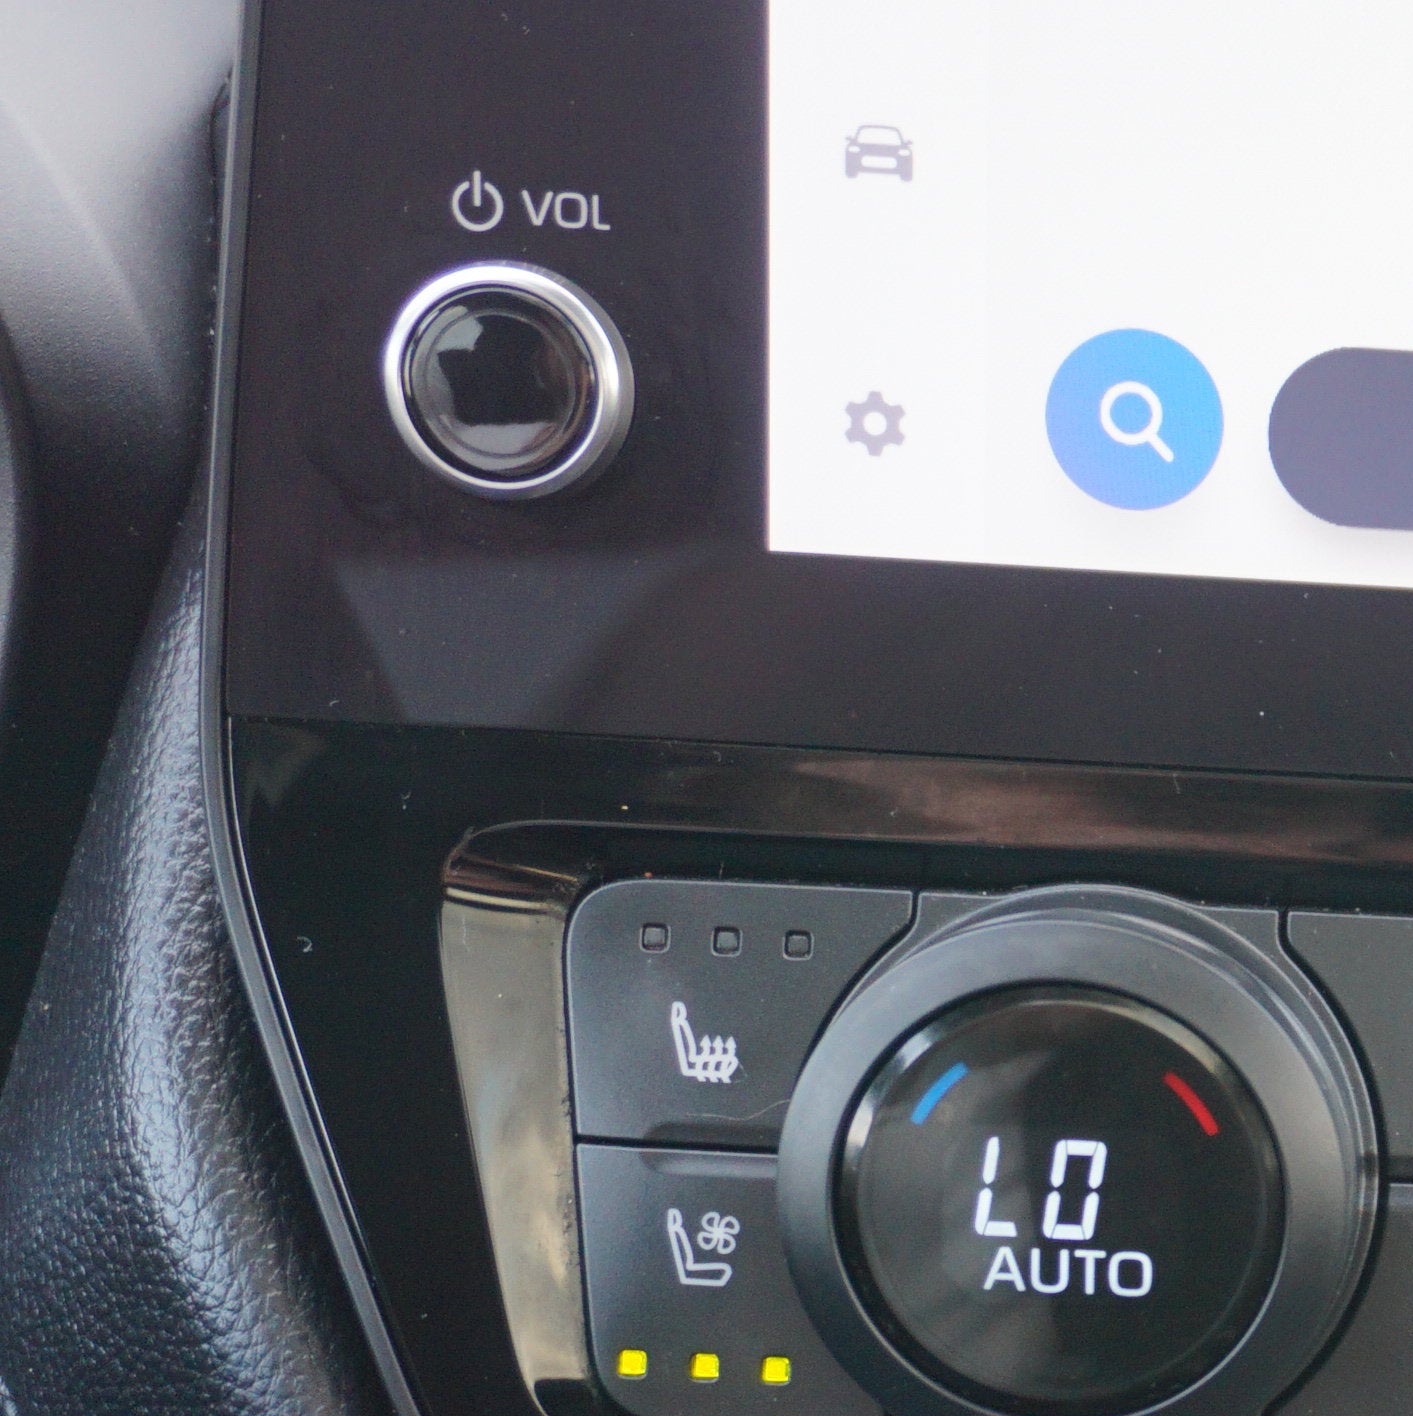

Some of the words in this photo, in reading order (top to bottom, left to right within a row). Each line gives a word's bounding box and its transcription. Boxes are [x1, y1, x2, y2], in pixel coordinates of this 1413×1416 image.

[521, 189, 611, 231] VOL
[973, 1136, 1107, 1241] LO
[983, 1245, 1153, 1297] AUTO
